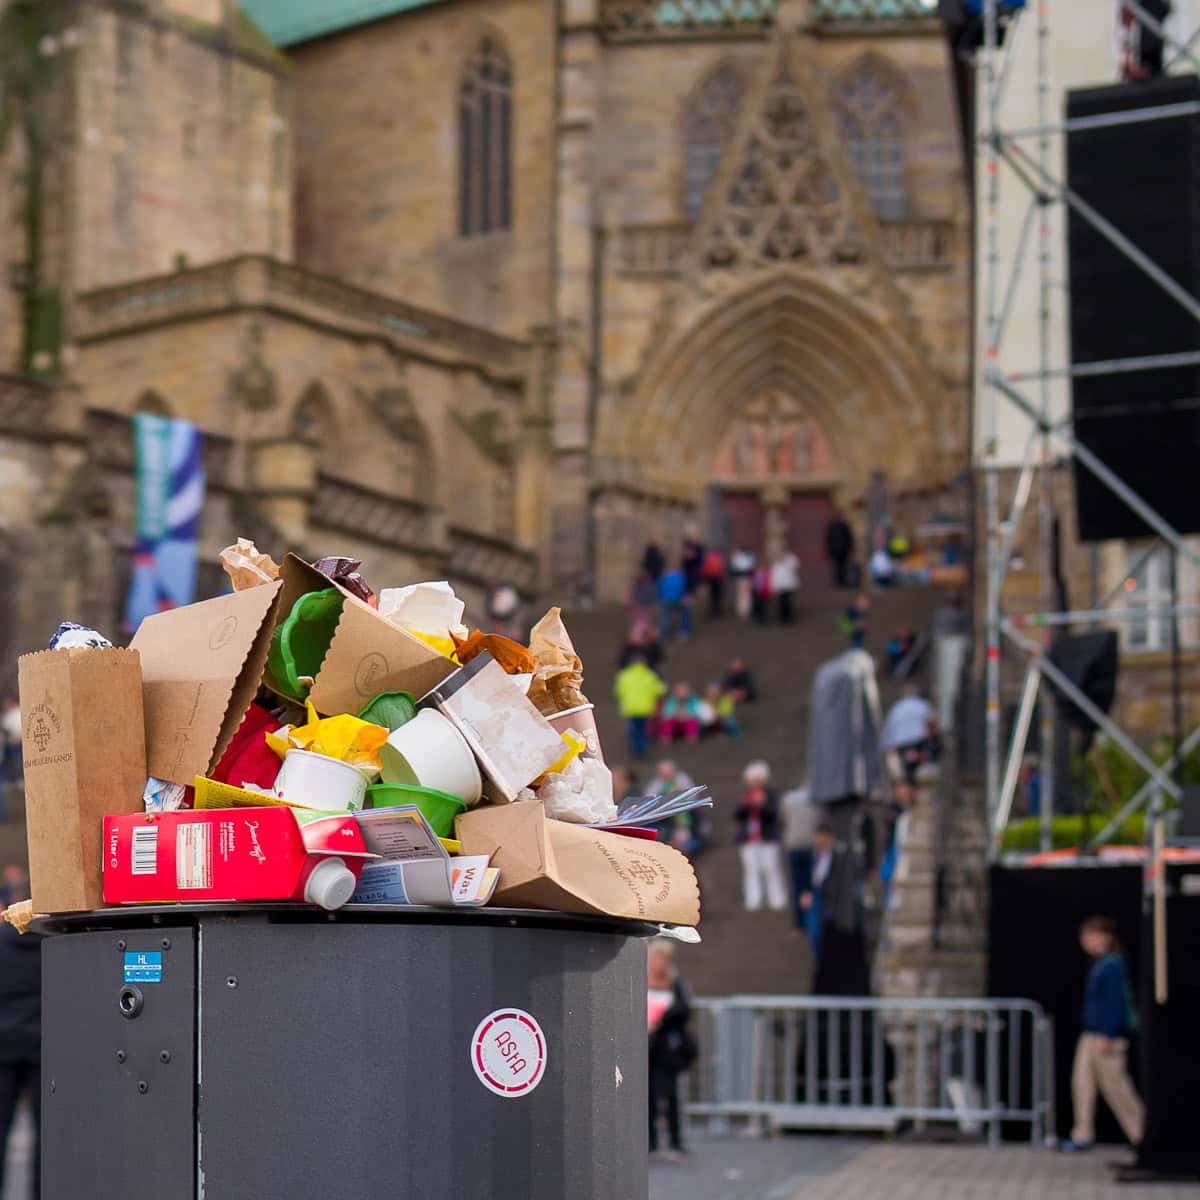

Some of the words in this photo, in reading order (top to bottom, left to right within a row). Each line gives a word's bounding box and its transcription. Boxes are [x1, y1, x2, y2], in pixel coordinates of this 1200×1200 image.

[111, 834, 120, 857] Liter
[137, 954, 148, 965] HL
[494, 1031, 527, 1076] AStA
